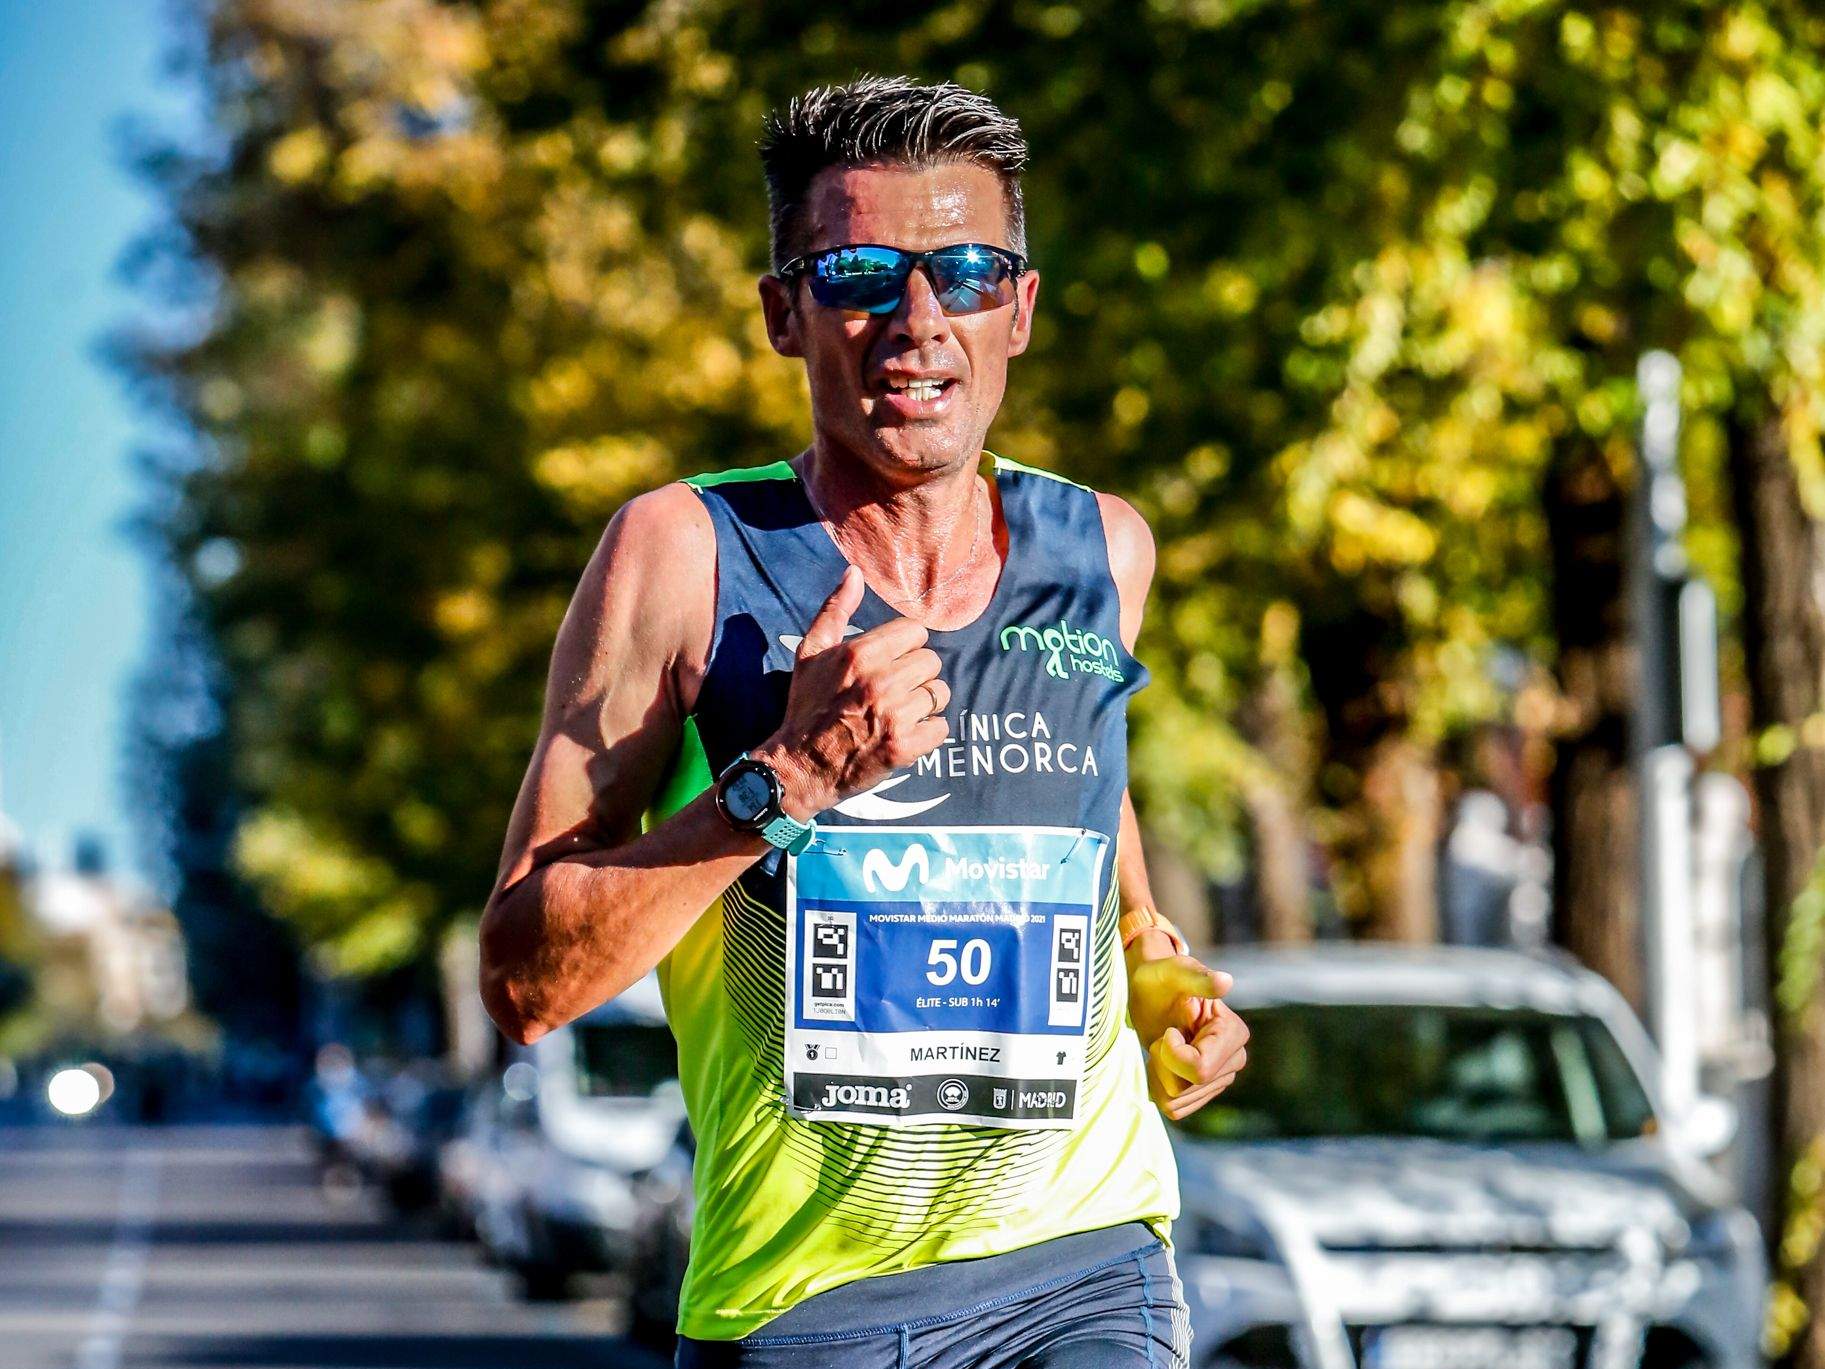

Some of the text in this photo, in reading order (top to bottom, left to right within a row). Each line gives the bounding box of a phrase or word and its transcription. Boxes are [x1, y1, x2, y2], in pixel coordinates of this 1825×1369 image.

[1000, 620, 1119, 672] motion
[943, 709, 1051, 743] ÍNICA
[916, 742, 1099, 778] MENORCA
[944, 856, 1050, 880] Movistar
[869, 914, 916, 923] MOVISTAR
[917, 914, 948, 923] MEDIO
[1030, 915, 1046, 924] 2021
[926, 938, 992, 986] 50
[916, 997, 941, 1008] ÉLITE
[948, 997, 968, 1007] SUB
[971, 997, 983, 1007] 1h
[910, 1042, 1000, 1062] MARTÍNEZ
[821, 1081, 911, 1108] joma
[1018, 1091, 1066, 1109] MADRID
